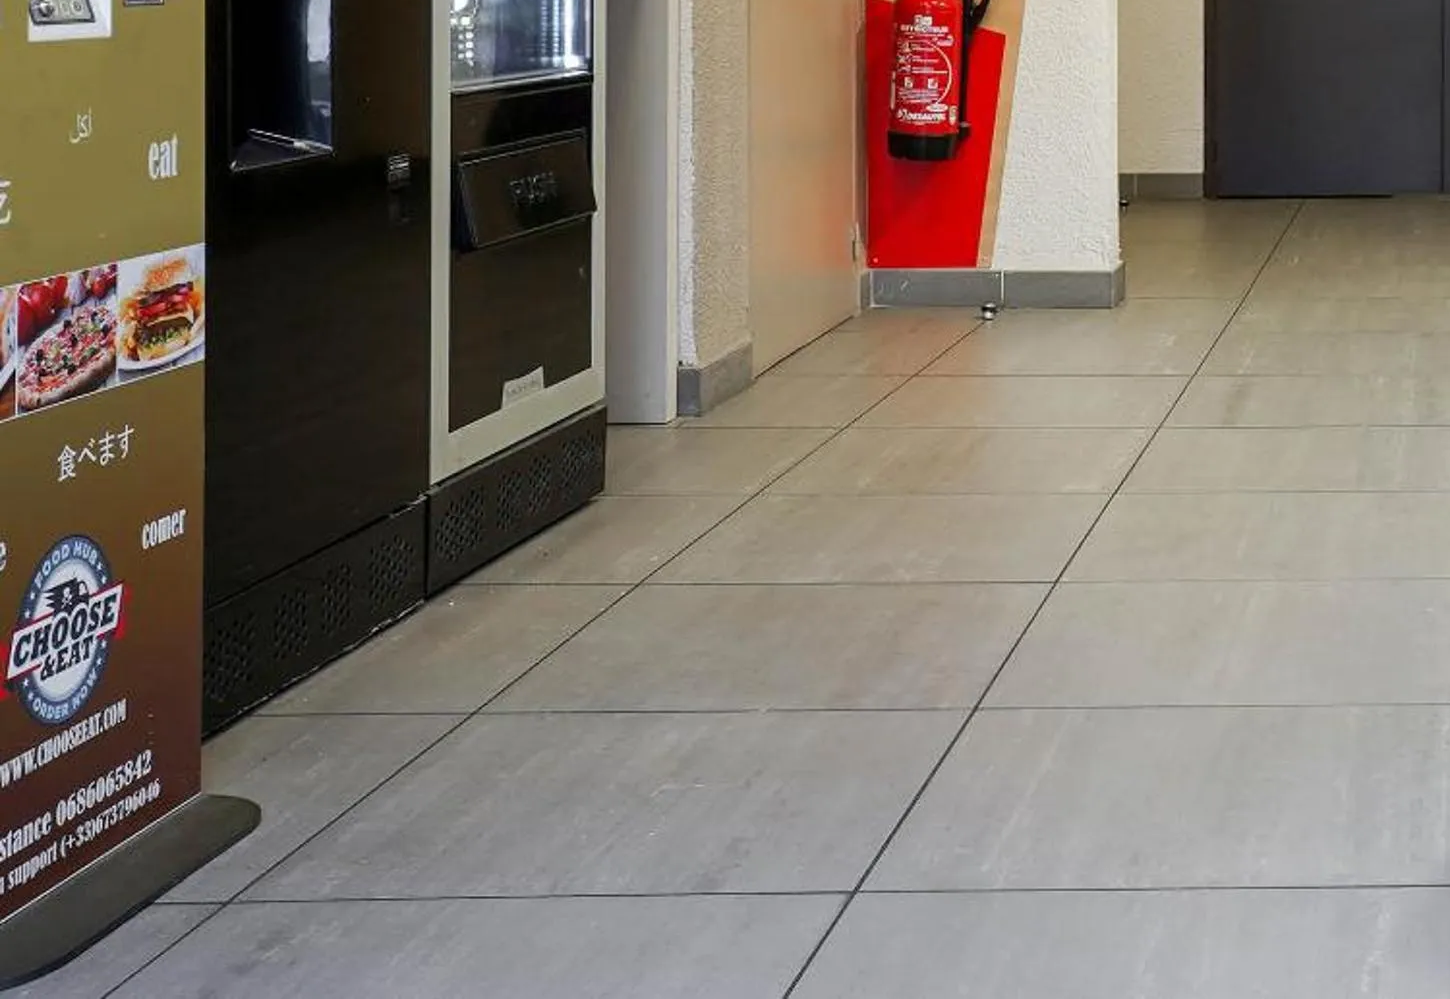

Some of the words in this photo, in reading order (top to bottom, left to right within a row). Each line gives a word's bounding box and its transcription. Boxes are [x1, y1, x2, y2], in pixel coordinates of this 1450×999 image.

[148, 132, 179, 181] eat
[57, 423, 135, 482] 食べます
[141, 508, 187, 550] comer
[34, 545, 71, 589] FOOD
[13, 593, 119, 669] CHOOSE
[32, 698, 70, 720] ORDER
[72, 668, 99, 711] NOW
[56, 749, 152, 827] 0686065842
[8, 839, 58, 890] support
